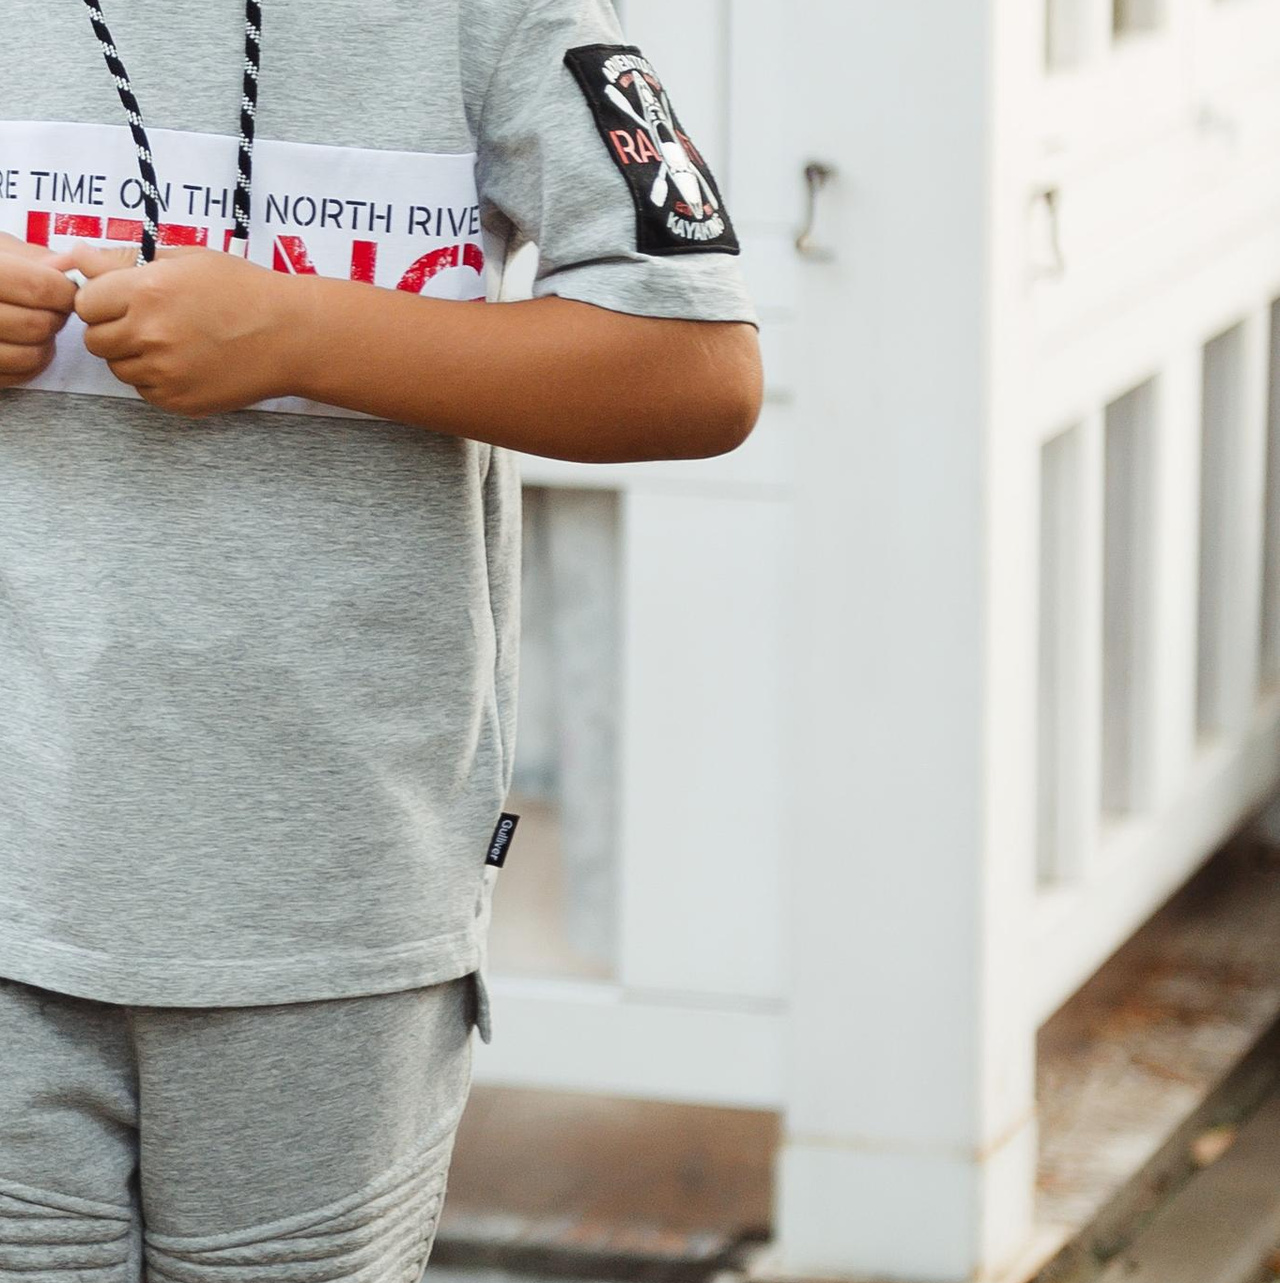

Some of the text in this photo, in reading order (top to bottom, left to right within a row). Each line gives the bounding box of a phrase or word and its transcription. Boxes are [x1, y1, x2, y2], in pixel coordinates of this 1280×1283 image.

[30, 171, 107, 205] TIME
[183, 184, 240, 219] TH
[265, 193, 392, 233] NORTH
[408, 205, 479, 237] RIVE
[490, 819, 513, 861] Gulliver
